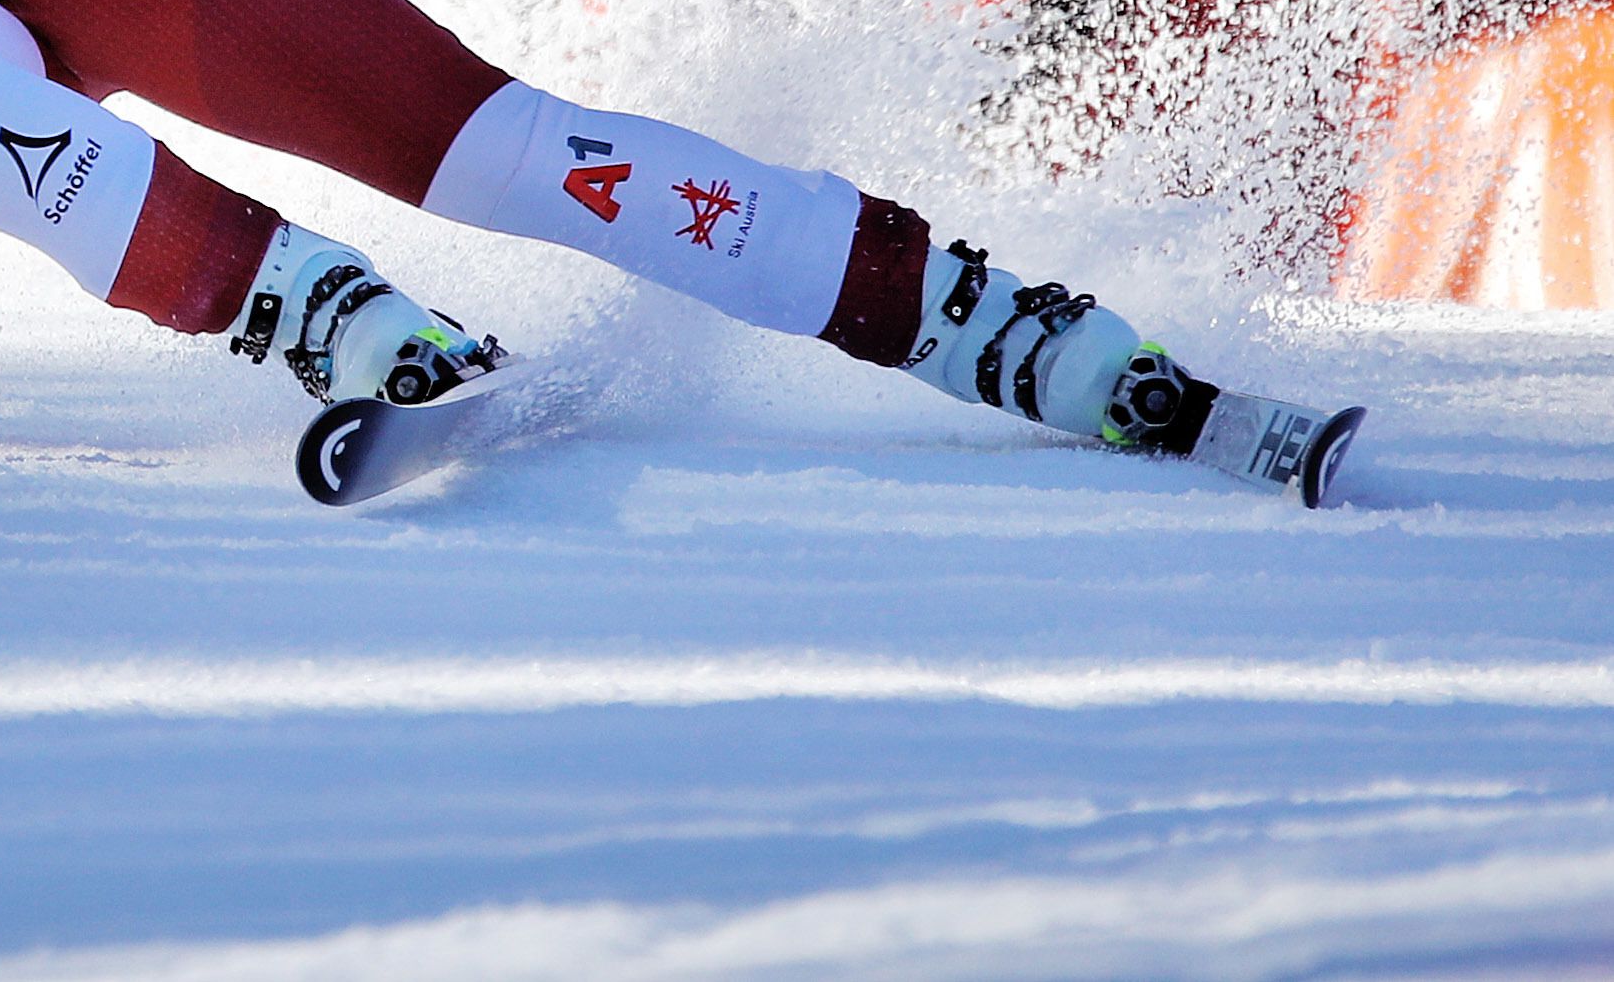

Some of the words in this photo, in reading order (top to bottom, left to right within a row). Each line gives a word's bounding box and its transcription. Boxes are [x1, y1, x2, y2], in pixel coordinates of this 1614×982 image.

[563, 135, 632, 224] A1
[728, 237, 747, 259] Ski
[738, 190, 759, 237] Austria
